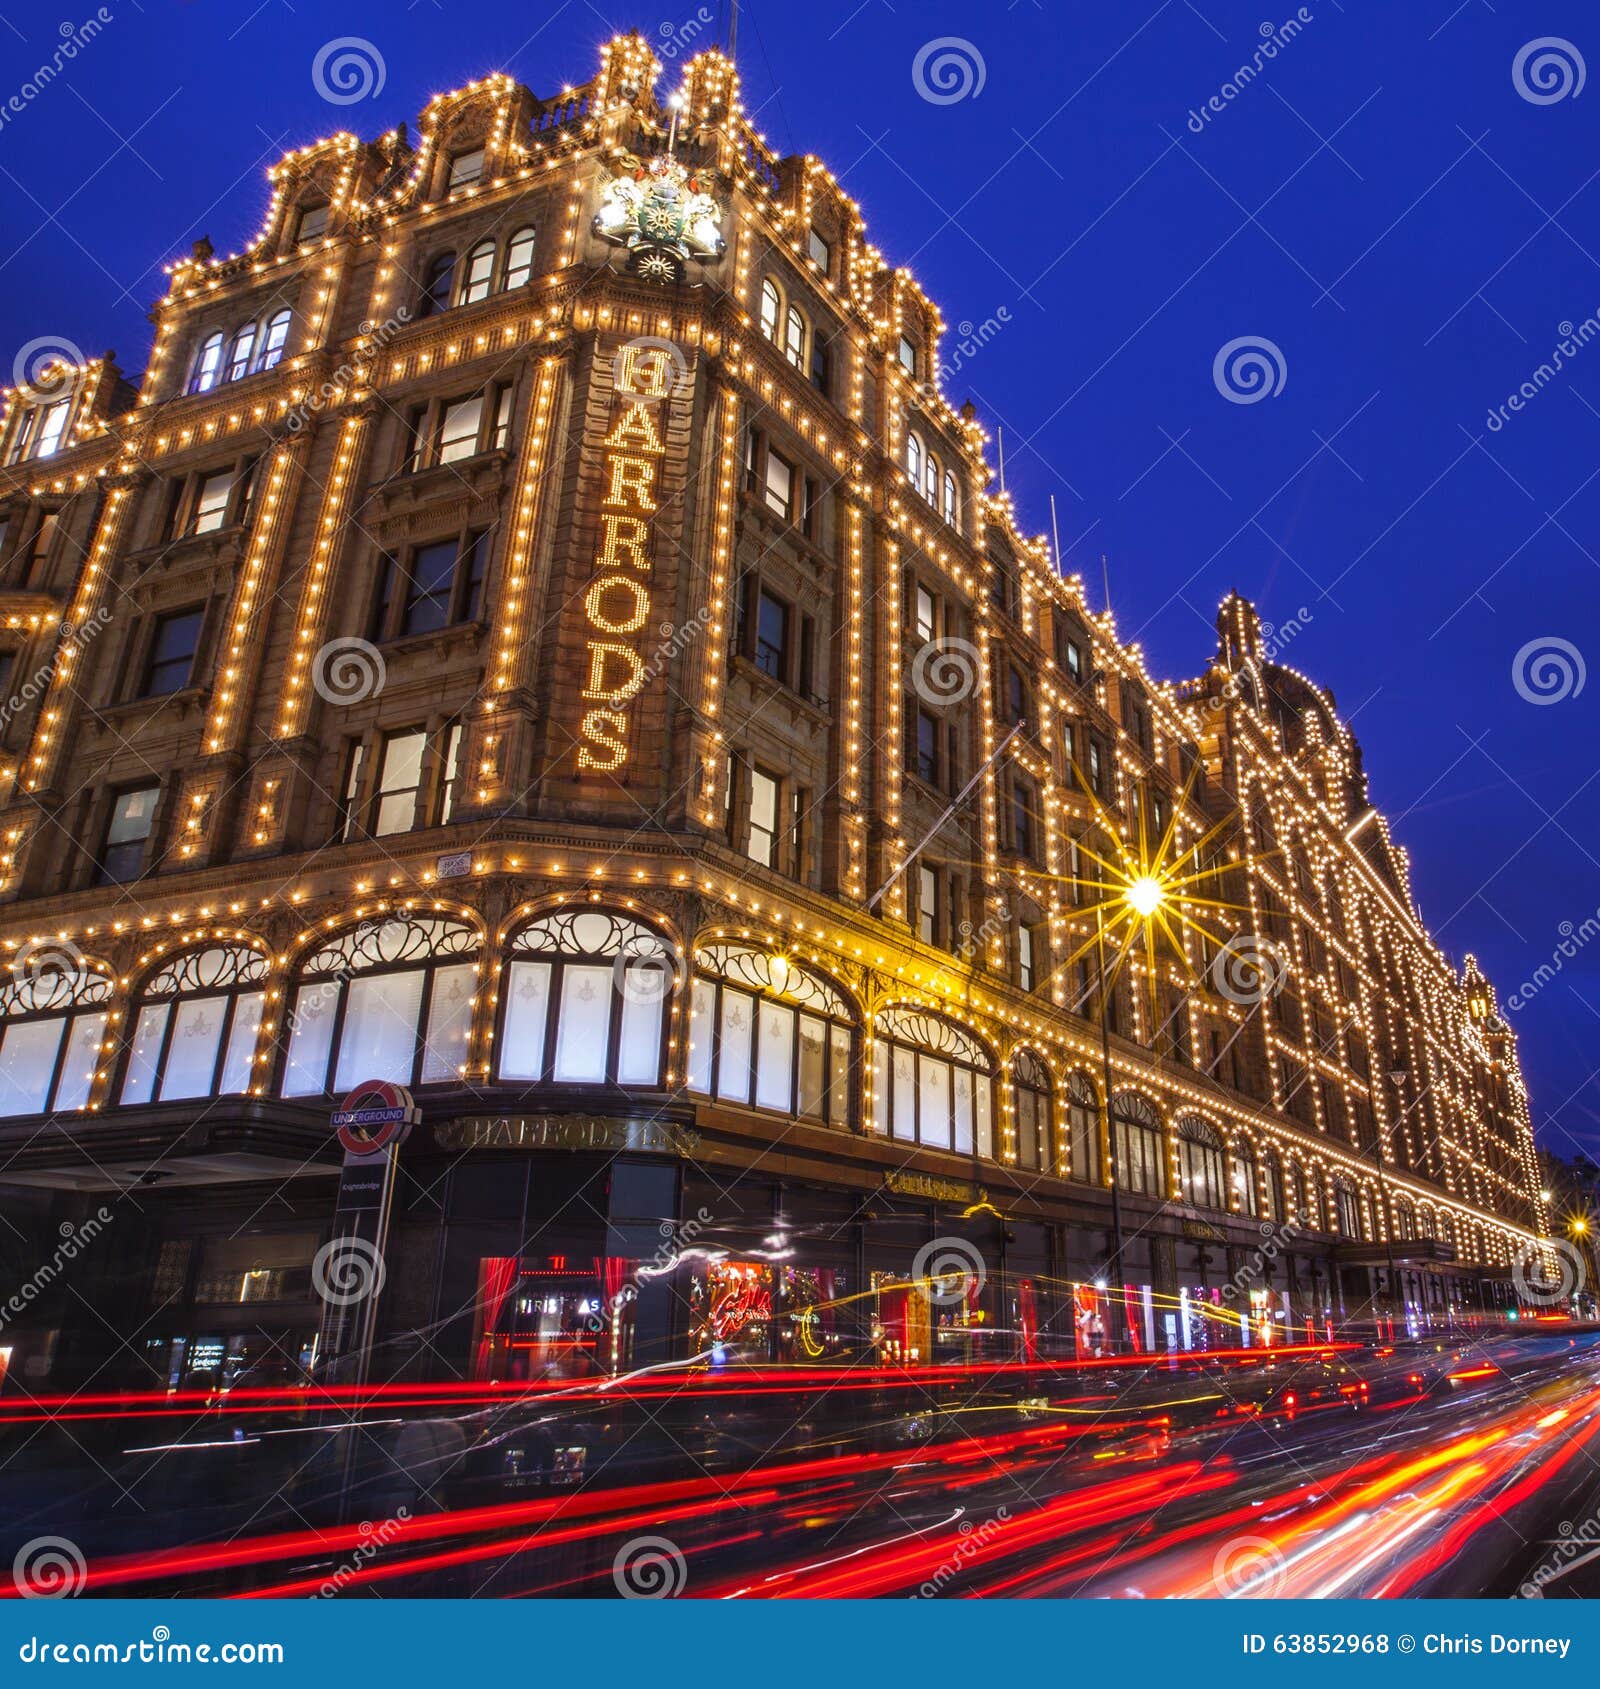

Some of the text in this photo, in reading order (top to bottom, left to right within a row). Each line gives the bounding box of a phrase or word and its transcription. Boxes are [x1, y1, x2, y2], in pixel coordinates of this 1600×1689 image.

[578, 344, 672, 771] HARRODS
[334, 1110, 403, 1124] UNDERGROUND
[342, 1182, 380, 1192] Knightsbridge
